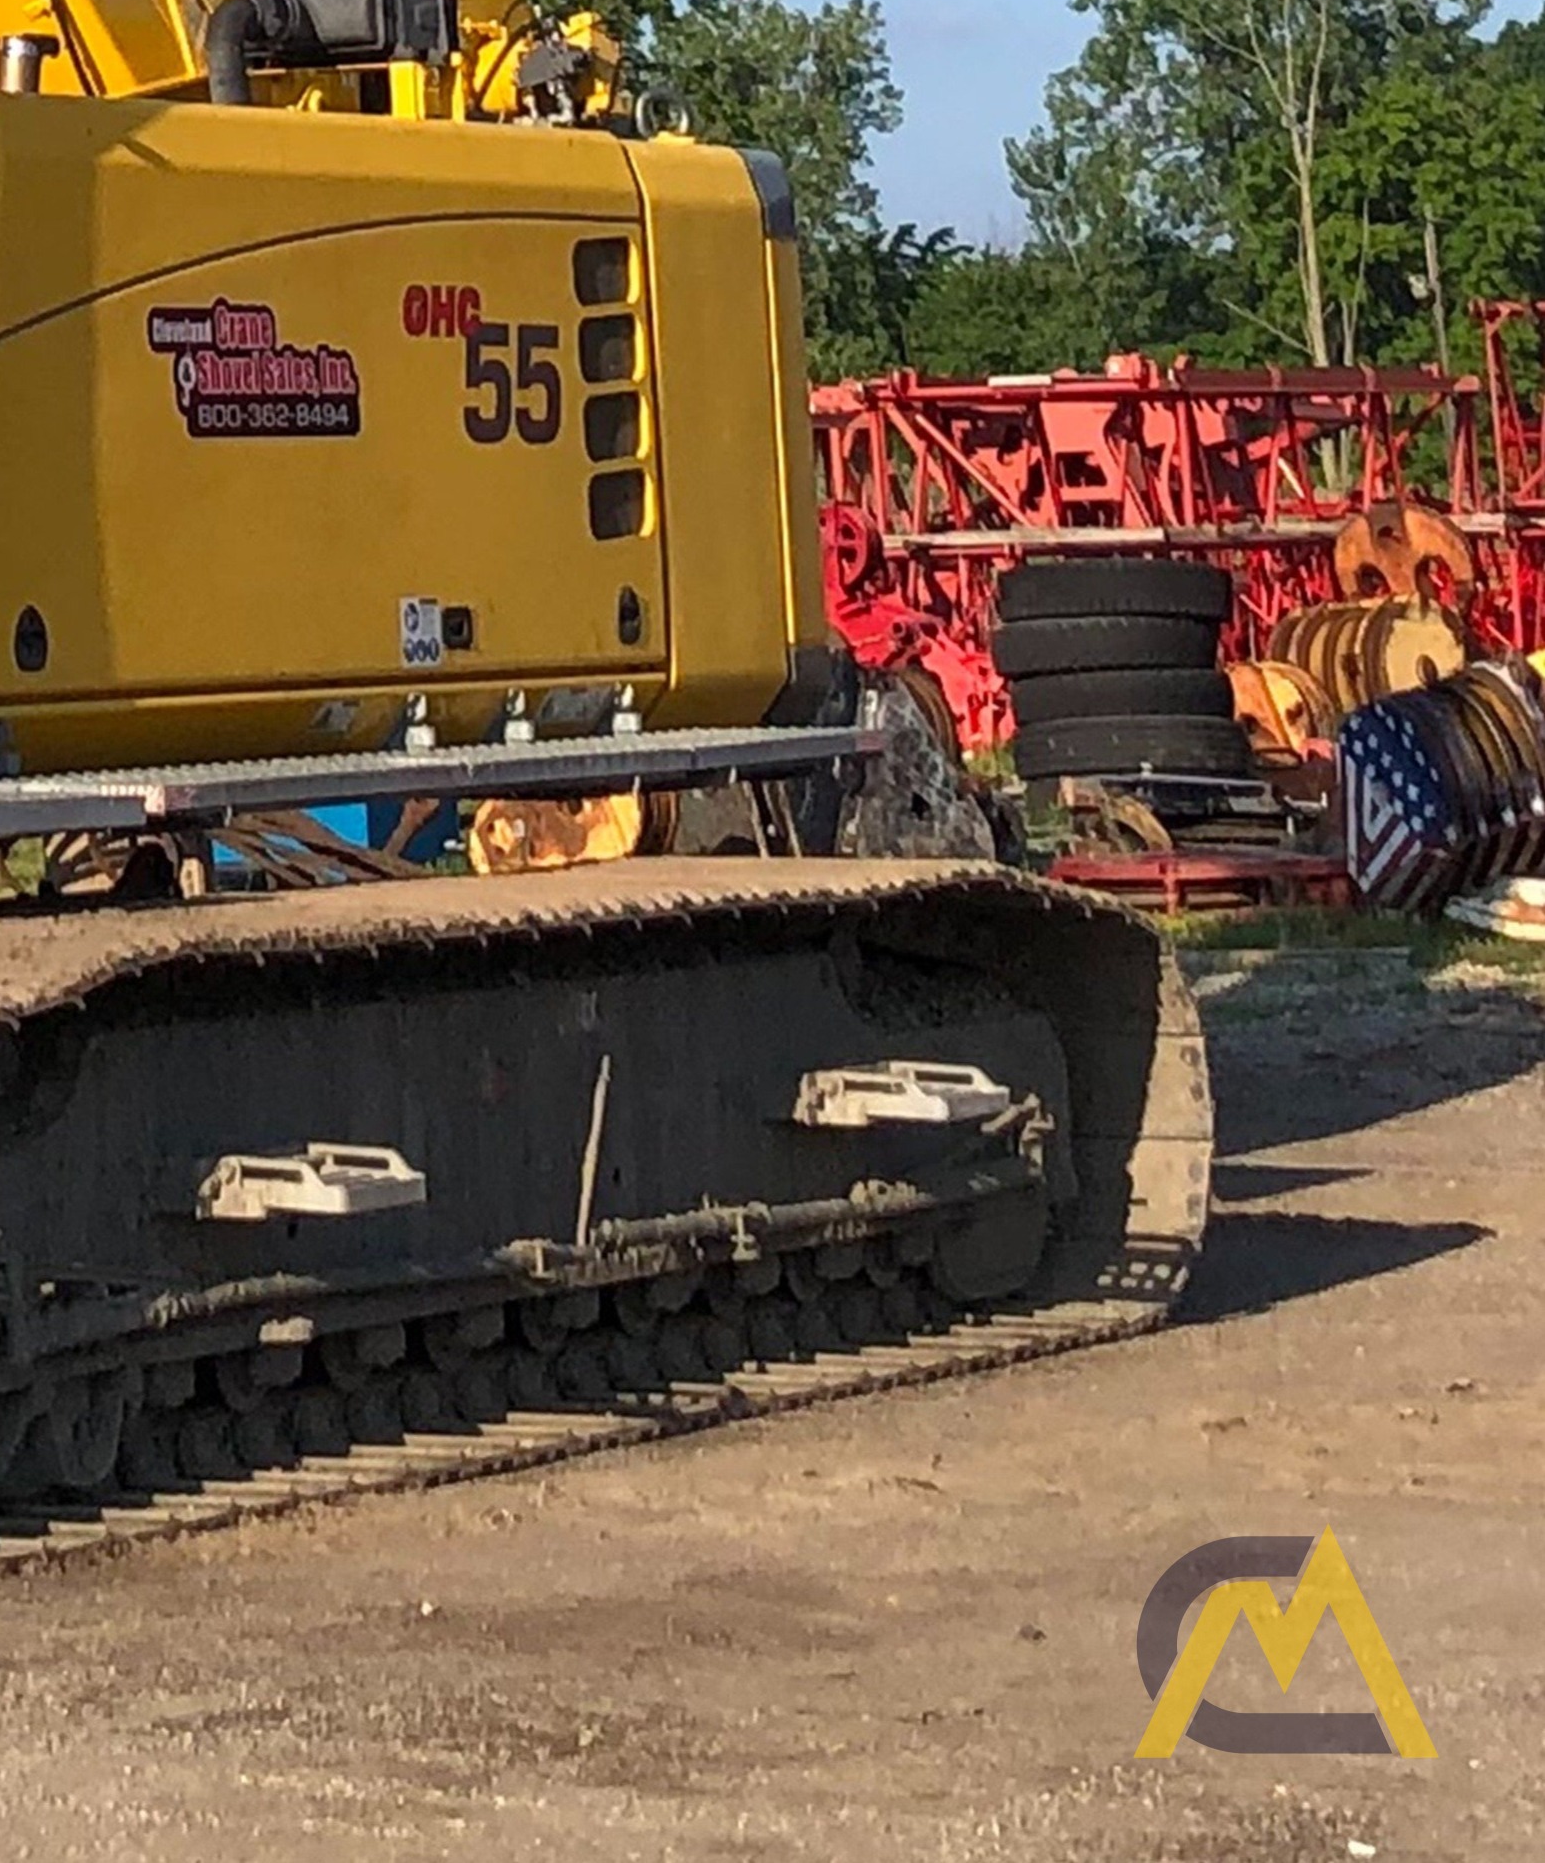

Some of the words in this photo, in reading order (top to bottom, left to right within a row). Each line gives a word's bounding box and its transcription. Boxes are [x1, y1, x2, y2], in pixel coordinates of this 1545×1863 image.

[214, 305, 273, 349] Crane
[195, 350, 261, 395] Shovel
[263, 350, 321, 399] Sales,
[319, 350, 356, 395] Inc.
[464, 323, 561, 444] 55
[197, 403, 349, 428] 800-362-8494
